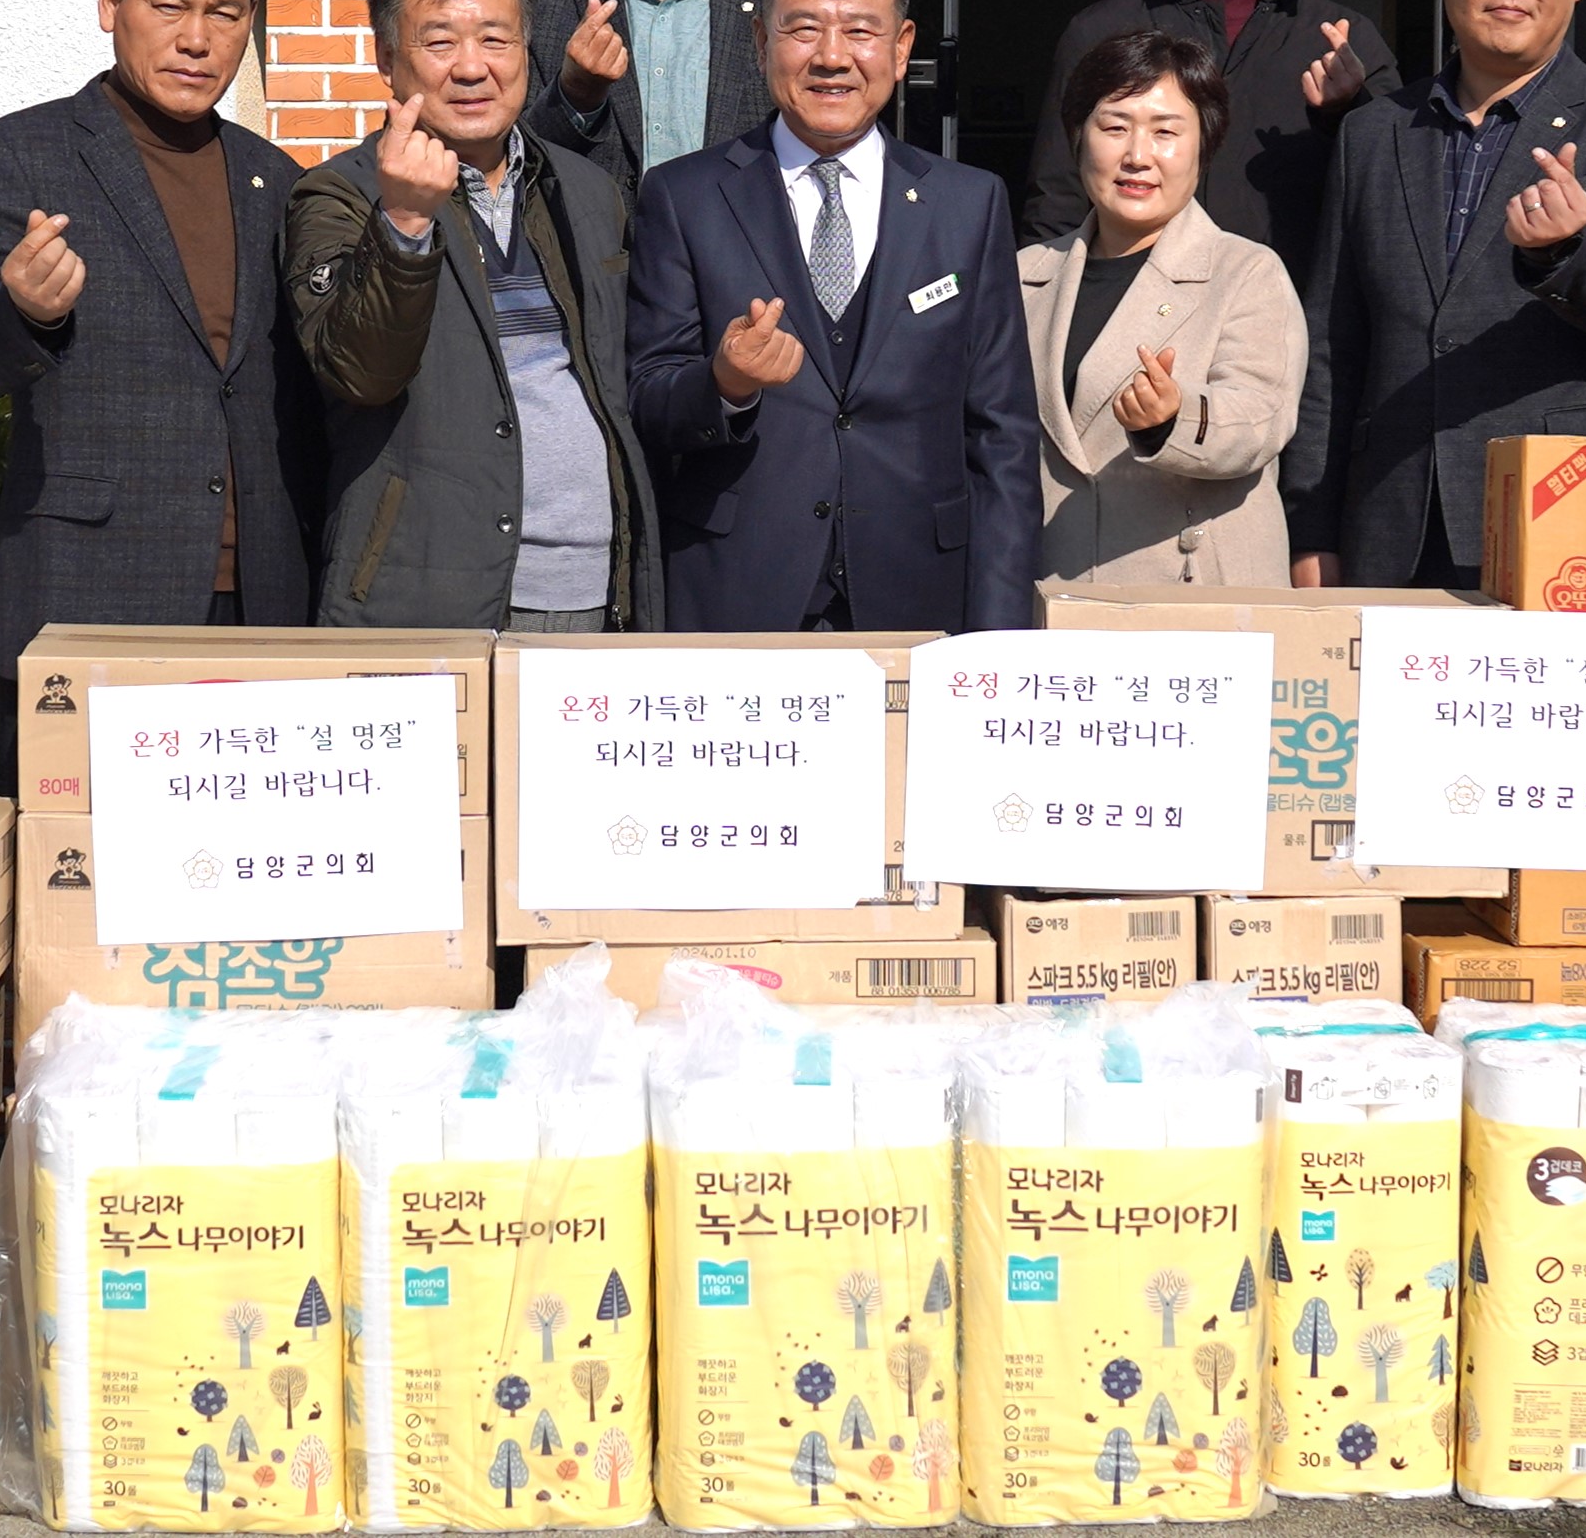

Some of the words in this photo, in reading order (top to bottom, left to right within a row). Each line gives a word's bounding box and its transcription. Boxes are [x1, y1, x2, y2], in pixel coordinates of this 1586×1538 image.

[1321, 646, 1346, 660] 제품
[1399, 654, 1450, 682] 온정
[1468, 655, 1548, 685] 가득한
[947, 671, 999, 699] 온정
[1017, 673, 1098, 703] 가득한
[1272, 677, 1329, 709] 미엄
[558, 695, 610, 723] 온정
[627, 694, 709, 723] 가득한
[1435, 700, 1514, 729] 되시길
[129, 730, 181, 758] 온정
[198, 726, 280, 755] 가득한
[982, 717, 1062, 747] 되시길
[1079, 719, 1195, 748] 바랍니다.
[595, 740, 674, 768] 되시길
[692, 740, 808, 768] 바랍니다.
[39, 778, 81, 797] 80매
[168, 773, 248, 802] 되시길
[265, 768, 382, 799] 바랍니다.
[1045, 802, 1183, 829] 담양군의회
[660, 824, 799, 848] 담양군의회
[236, 852, 375, 880] 담양군의회
[1044, 917, 1069, 931] 애경
[1248, 919, 1272, 934] 애경
[829, 970, 852, 983] 제품
[1027, 965, 1073, 993] 스파크
[1122, 958, 1177, 991] 리필(안)
[1325, 959, 1380, 992] 리필(안)
[1300, 1151, 1365, 1168] 모나리자
[1534, 1157, 1583, 1182] 3겹데코
[695, 1171, 792, 1197] 모나리자
[1007, 1168, 1104, 1195] 모나리자
[1300, 1173, 1355, 1202] 녹스
[1359, 1171, 1451, 1197] 나무이야기
[99, 1194, 184, 1216] 모나리자
[402, 1191, 487, 1214] 모나리자
[695, 1202, 778, 1246] 녹스
[784, 1203, 929, 1240] 나무이야기
[1006, 1198, 1089, 1242] 녹스
[1095, 1202, 1239, 1237] 나무이야기
[1303, 1219, 1333, 1227] mona
[99, 1221, 172, 1258] 녹스
[177, 1224, 305, 1253] 나무이야기
[402, 1217, 474, 1255] 녹스
[480, 1217, 606, 1249] 나무이야기
[104, 1281, 143, 1293] mona
[407, 1278, 446, 1289] mona
[702, 1274, 745, 1285] mona
[1010, 1269, 1055, 1281] mona
[1523, 1461, 1564, 1473] 모나리자
